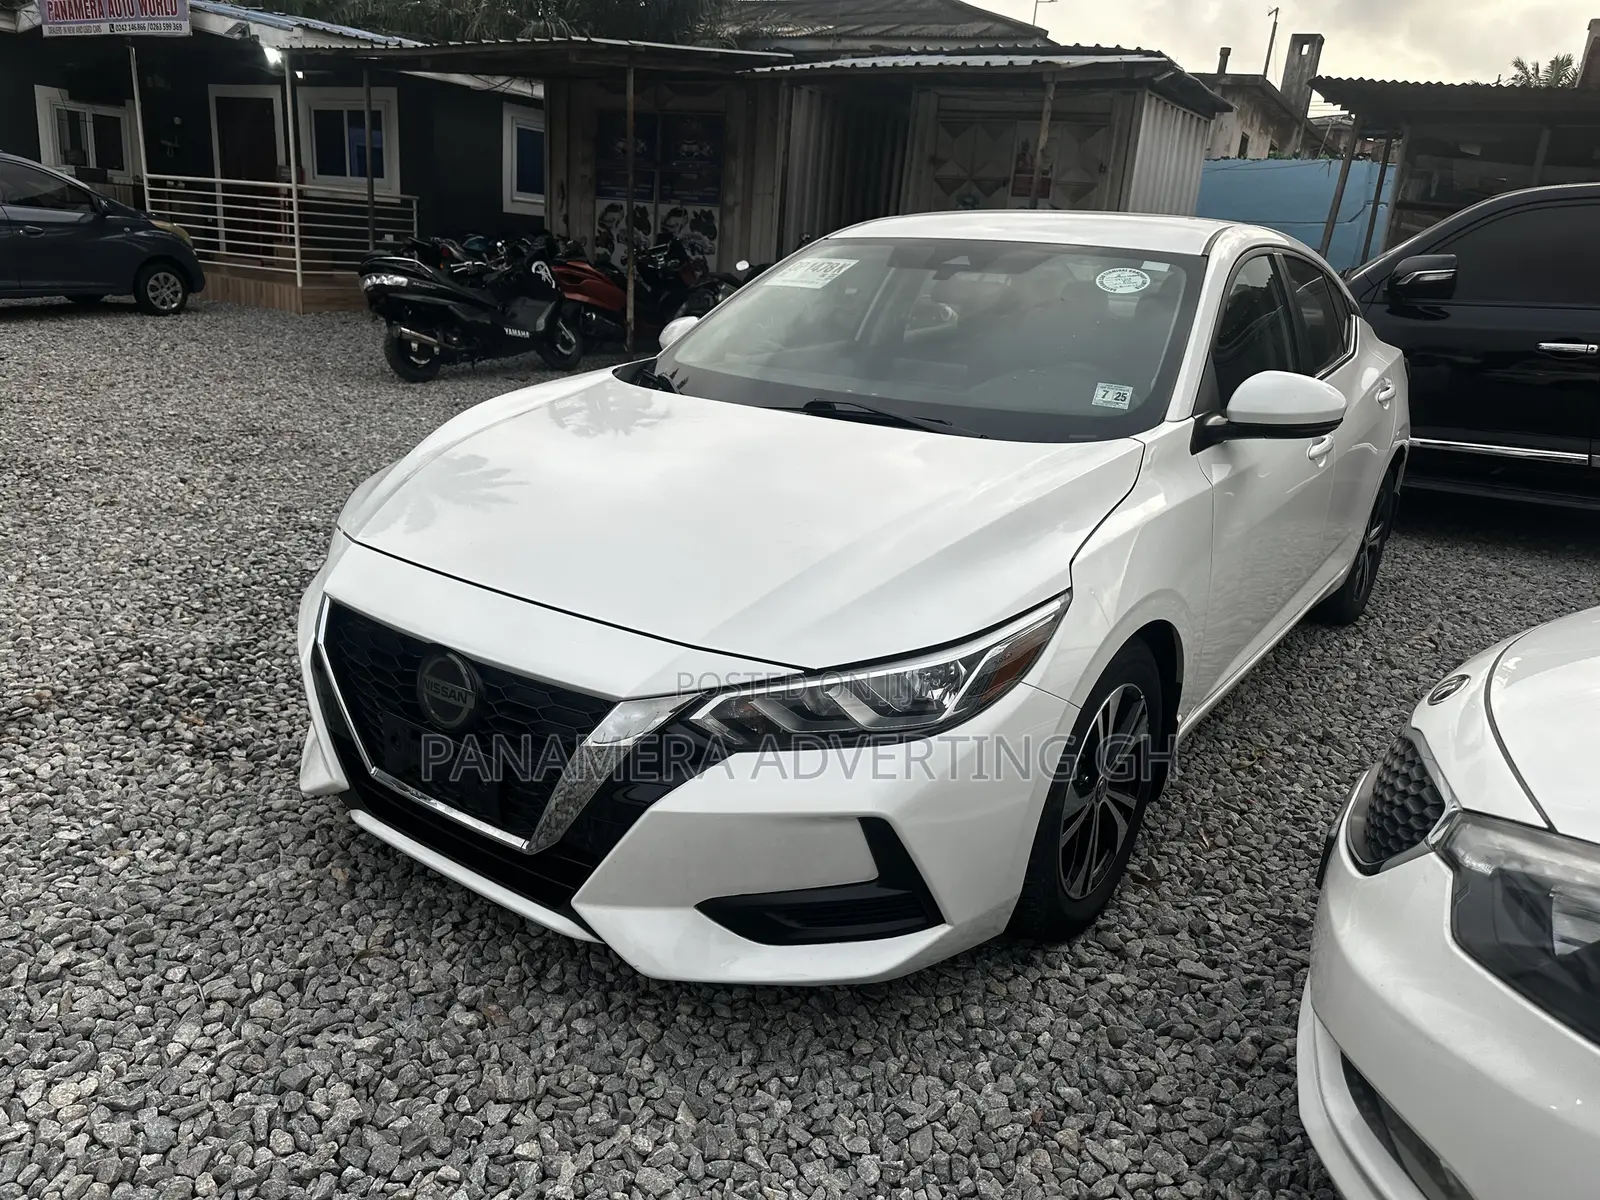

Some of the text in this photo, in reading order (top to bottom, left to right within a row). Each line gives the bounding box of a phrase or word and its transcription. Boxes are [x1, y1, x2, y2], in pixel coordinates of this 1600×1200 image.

[47, 0, 178, 21] PANAMERA AUTO WORLD
[115, 24, 128, 32] 0242
[504, 327, 530, 338] YAMAHA
[1101, 389, 1128, 402] 7 25
[424, 679, 468, 704] NISSAN
